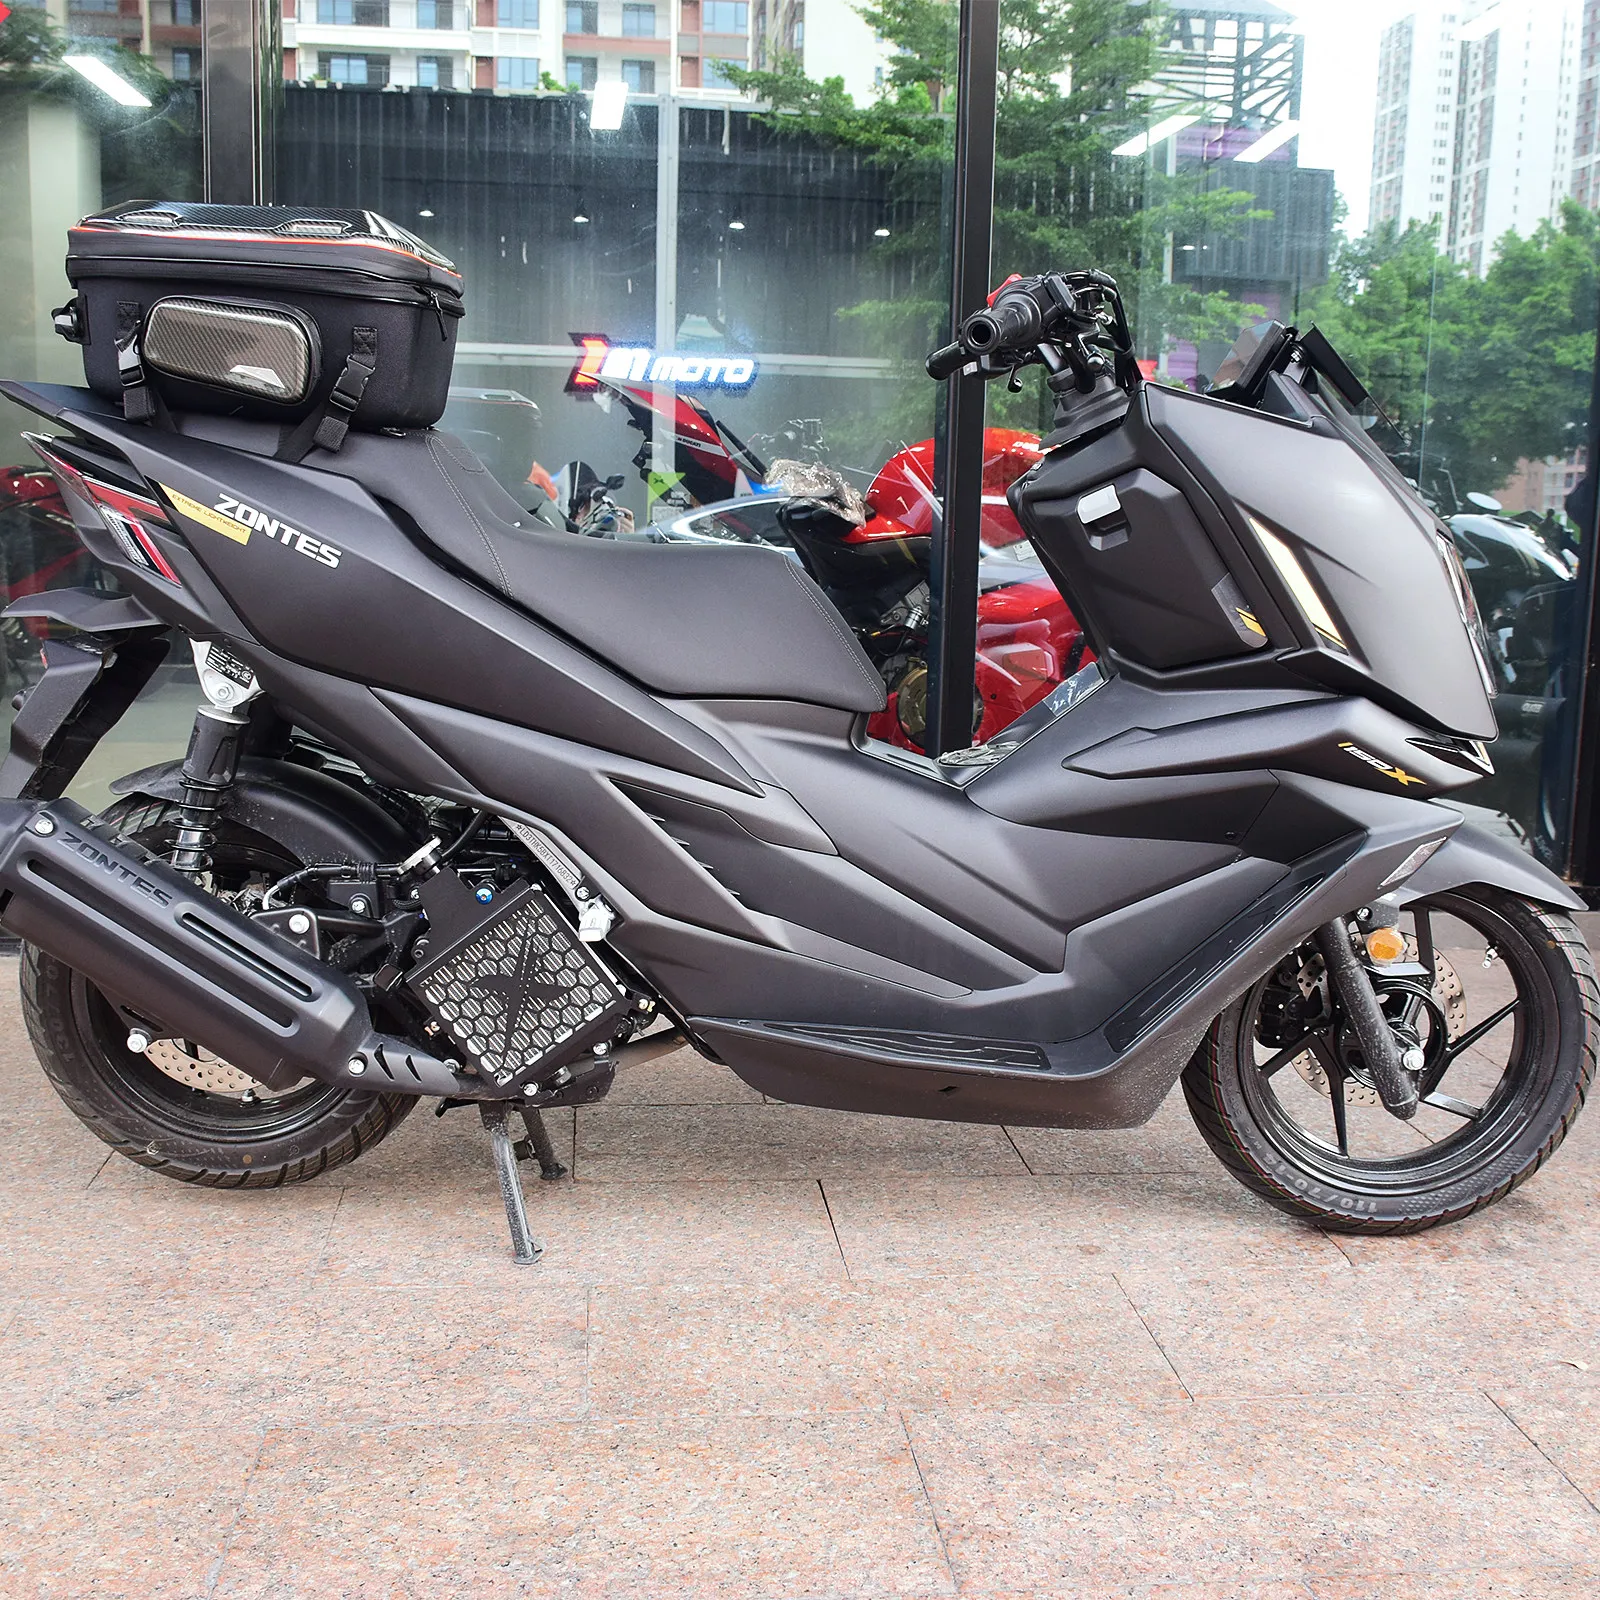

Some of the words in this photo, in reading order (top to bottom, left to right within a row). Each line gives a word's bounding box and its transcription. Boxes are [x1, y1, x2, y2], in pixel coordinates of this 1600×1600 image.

[682, 438, 702, 448] DUCATI
[172, 493, 203, 514] EXTREME
[203, 509, 246, 534] LIGHTWEIGHT
[213, 493, 342, 569] ZONTES
[57, 831, 173, 909] ZONTES
